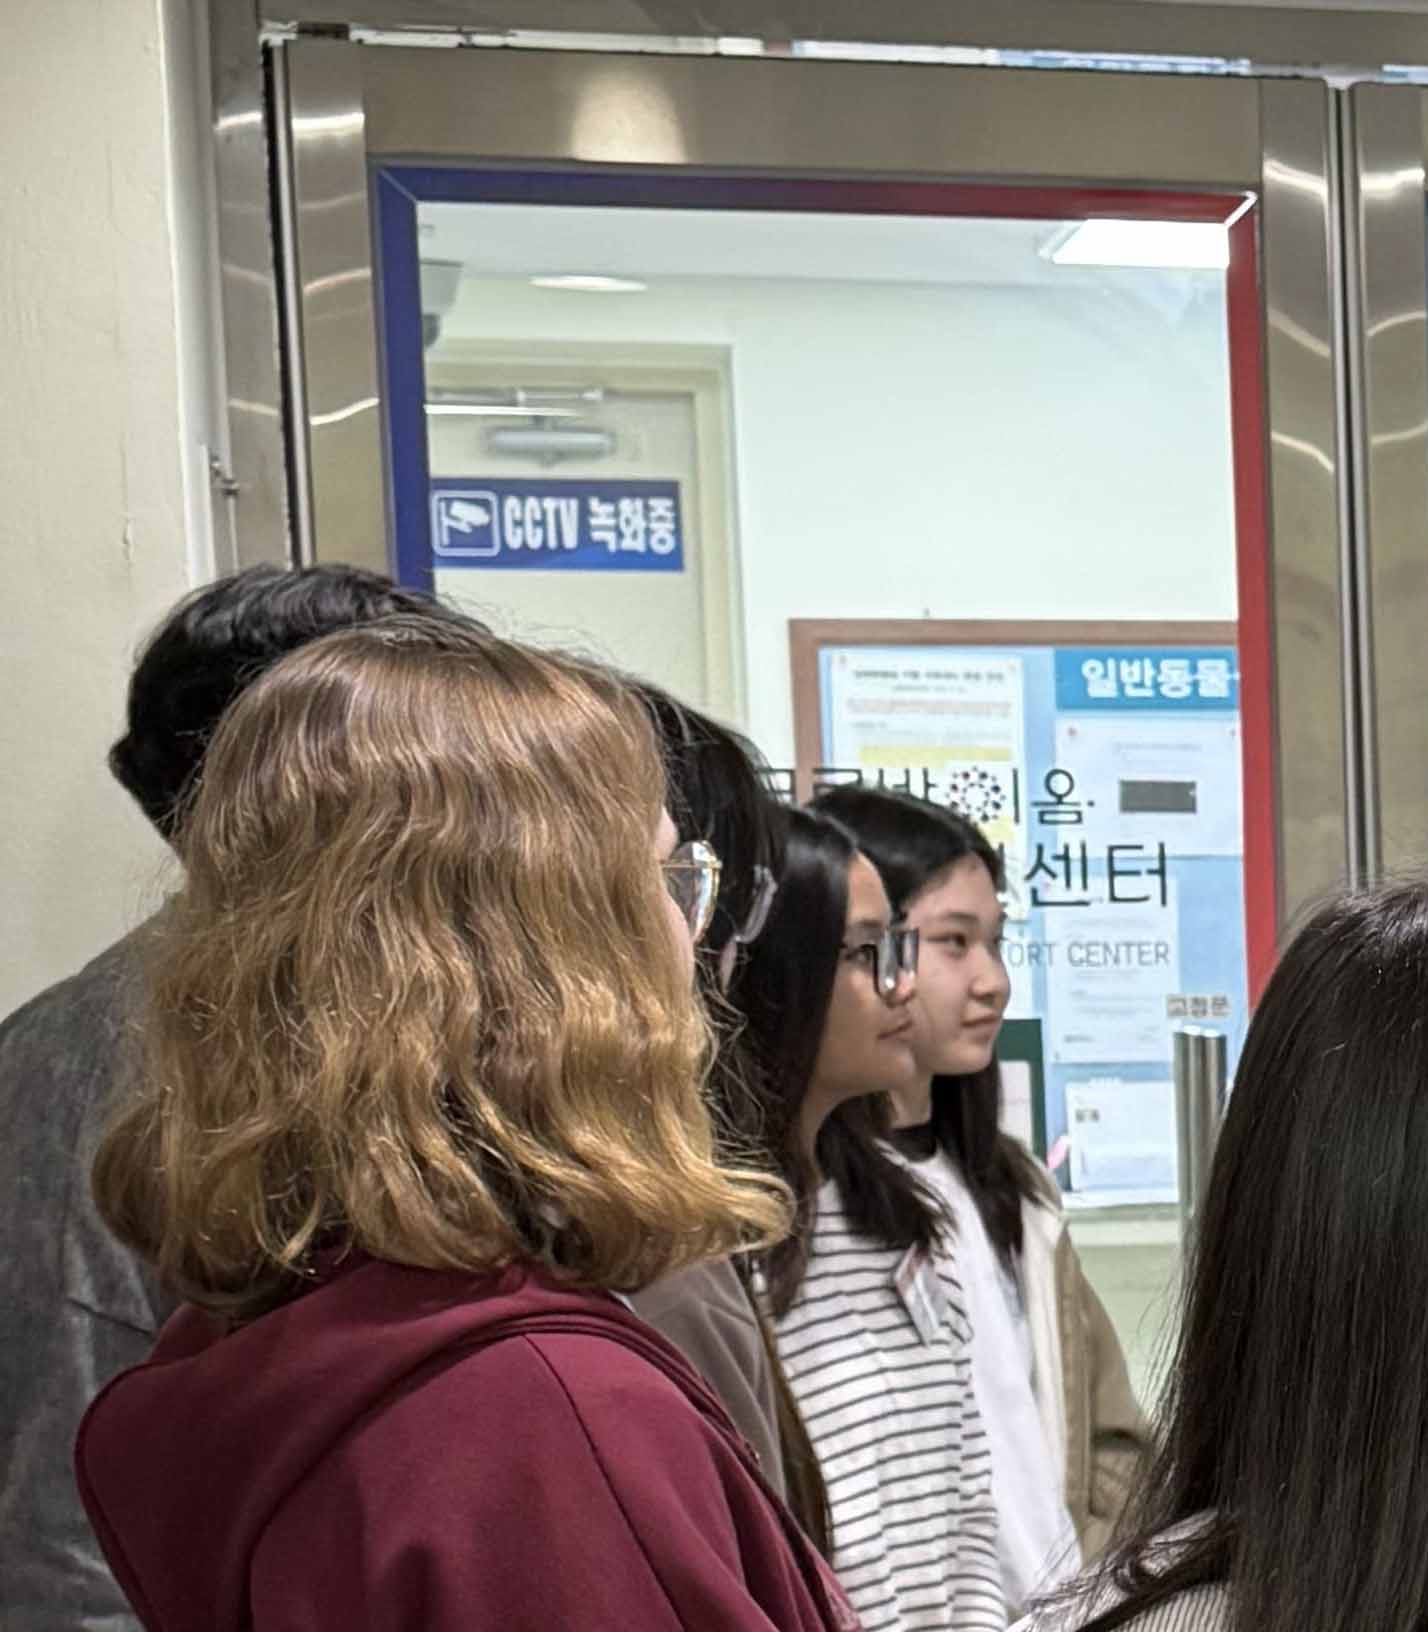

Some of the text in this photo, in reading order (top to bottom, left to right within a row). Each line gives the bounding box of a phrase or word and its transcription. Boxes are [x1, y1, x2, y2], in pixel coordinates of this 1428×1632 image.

[504, 496, 676, 554] CCTV 녹화중
[1066, 941, 1170, 967] CENTER
